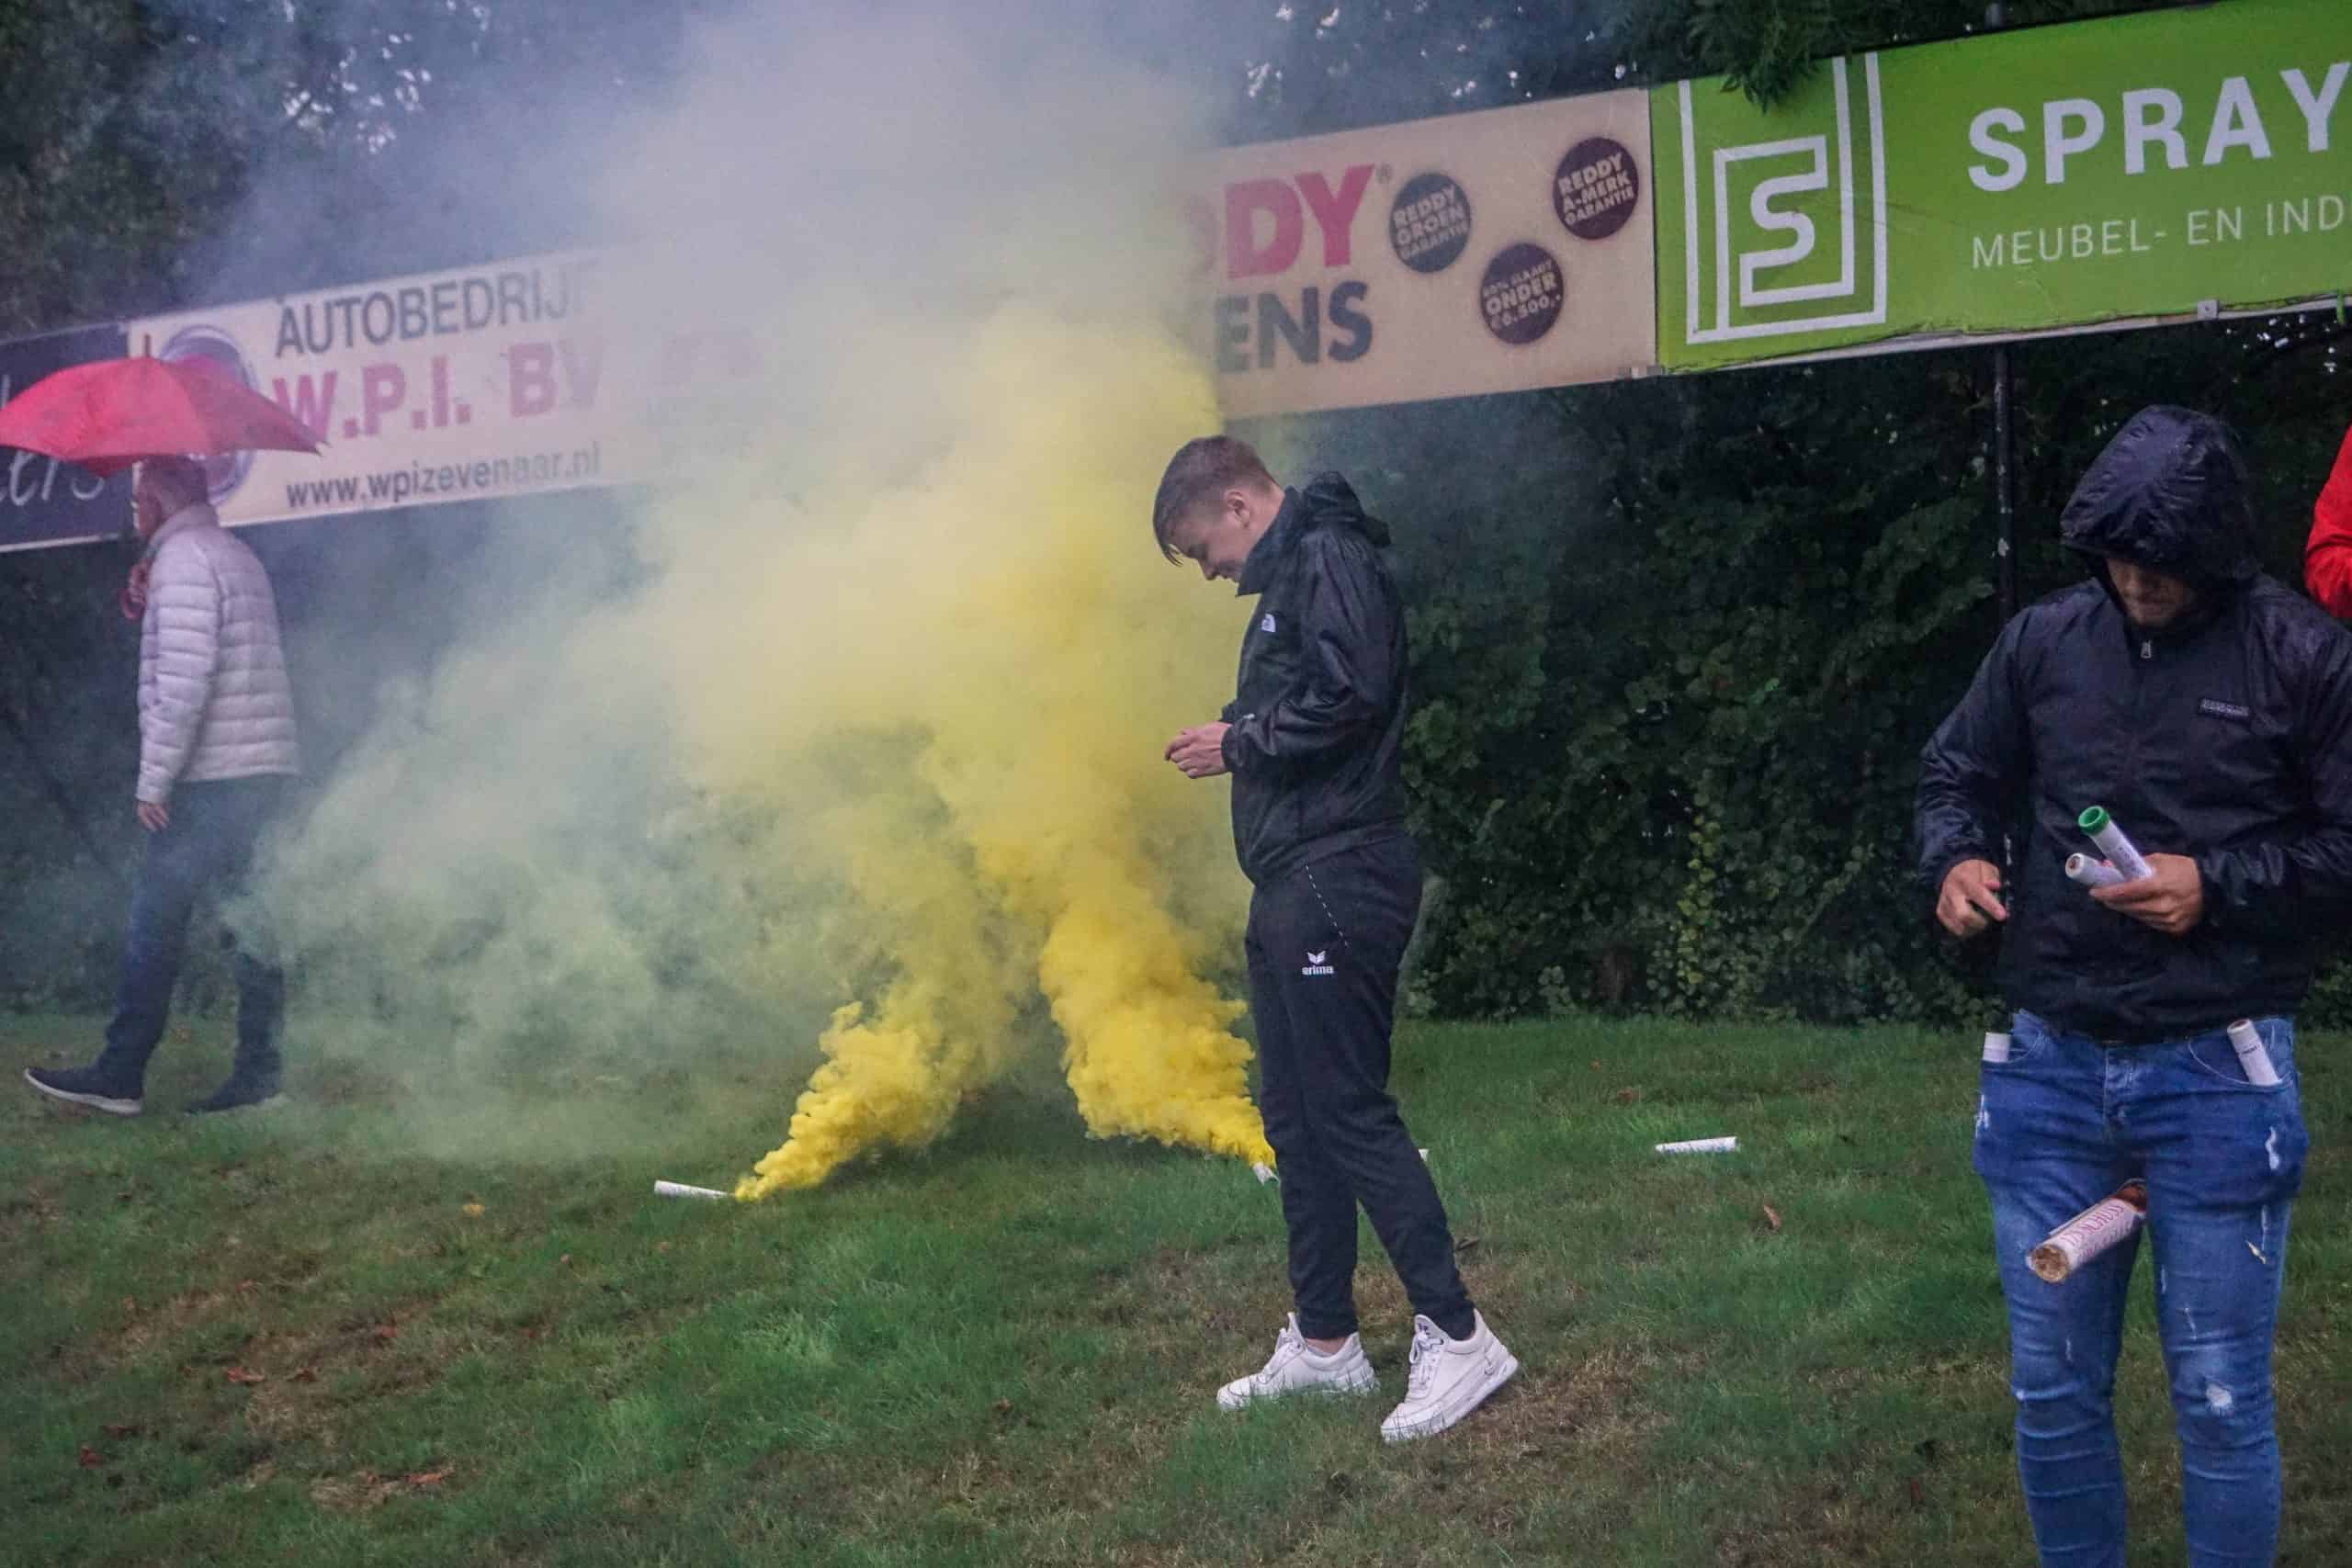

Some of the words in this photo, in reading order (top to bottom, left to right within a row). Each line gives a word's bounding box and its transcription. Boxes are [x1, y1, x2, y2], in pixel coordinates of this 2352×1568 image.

[1968, 62, 2352, 191] SPRAY
[1558, 152, 1623, 197] REDDY
[1562, 172, 1632, 212] A-MERK
[1393, 186, 1456, 227] REDDY
[1972, 219, 2168, 269] MEUBEL-
[2188, 206, 2243, 245] EN
[2267, 195, 2345, 237] IND
[1486, 272, 1557, 315] ONDER
[1302, 965, 1334, 976] erima
